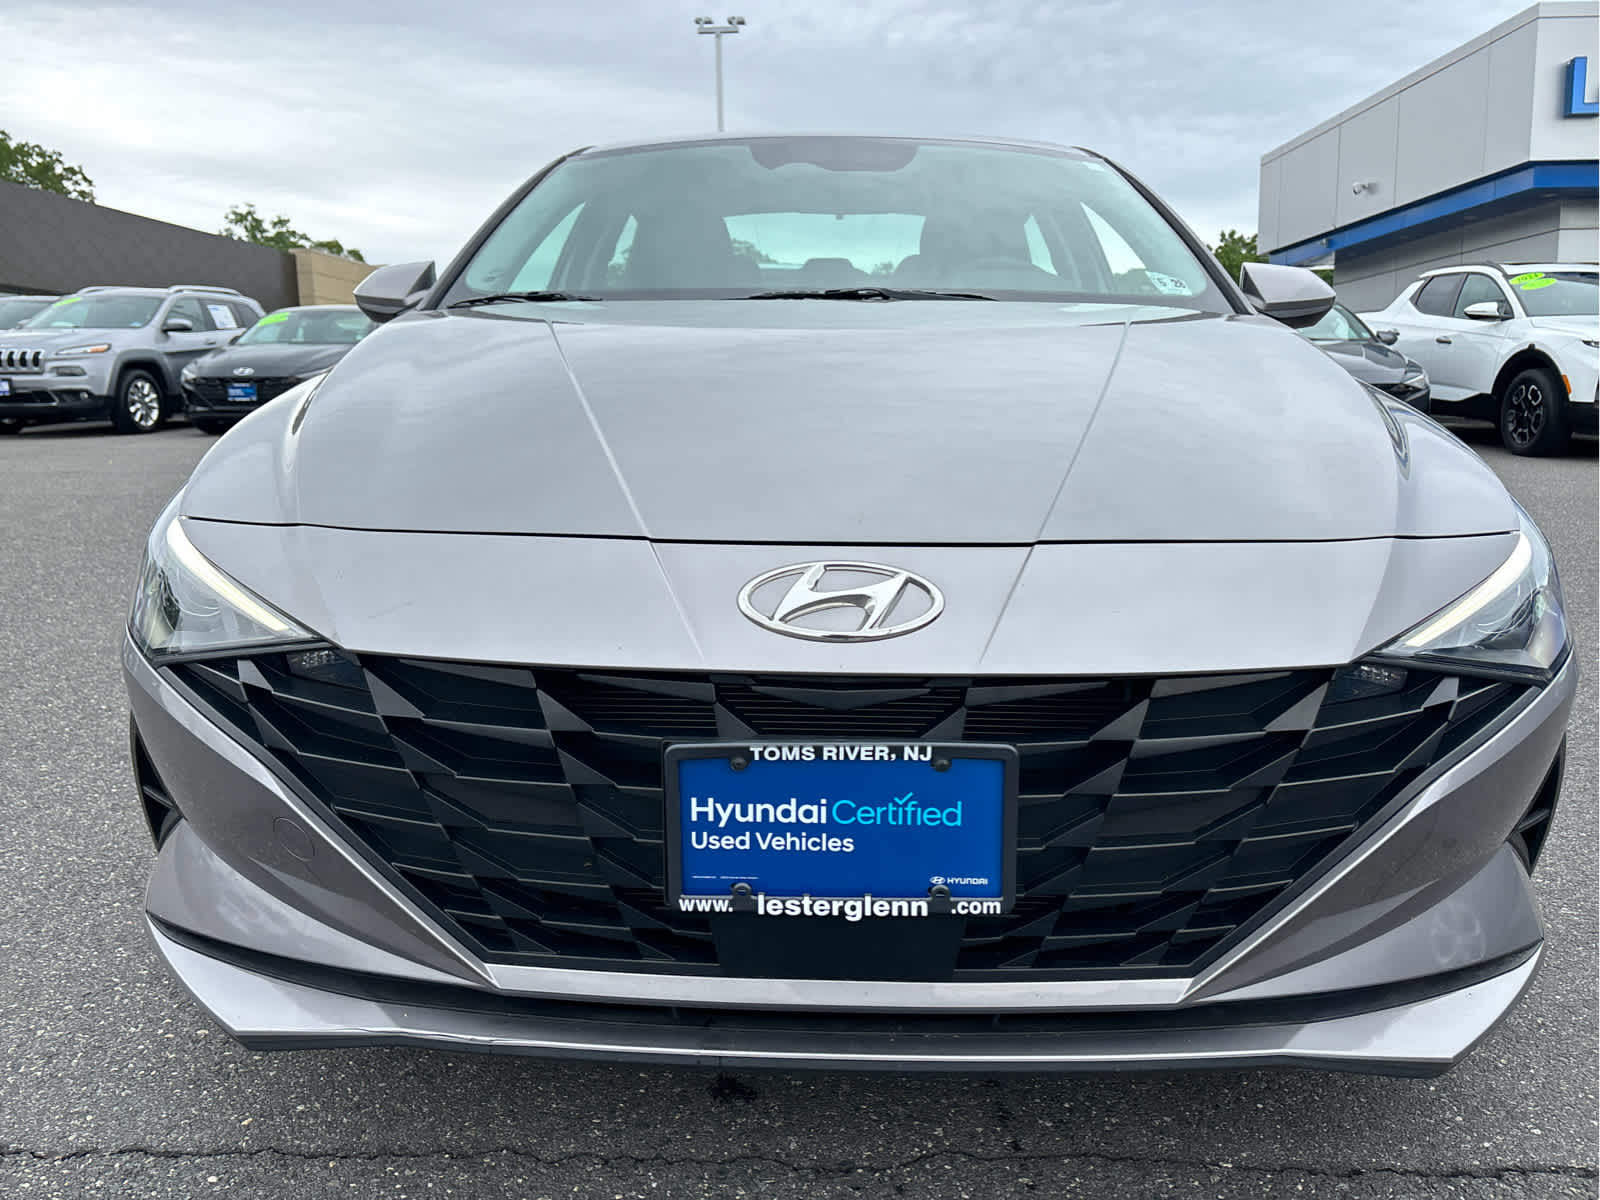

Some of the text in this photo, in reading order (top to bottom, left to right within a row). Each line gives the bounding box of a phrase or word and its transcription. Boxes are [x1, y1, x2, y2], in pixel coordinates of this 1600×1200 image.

[750, 746, 933, 762] TOMS RIVER, NJ
[690, 792, 963, 827] Hyundai Certified
[690, 831, 855, 852] Used Vehicles
[946, 876, 989, 885] HYUNDAI
[678, 894, 1002, 921] www. lesterglenn .com
